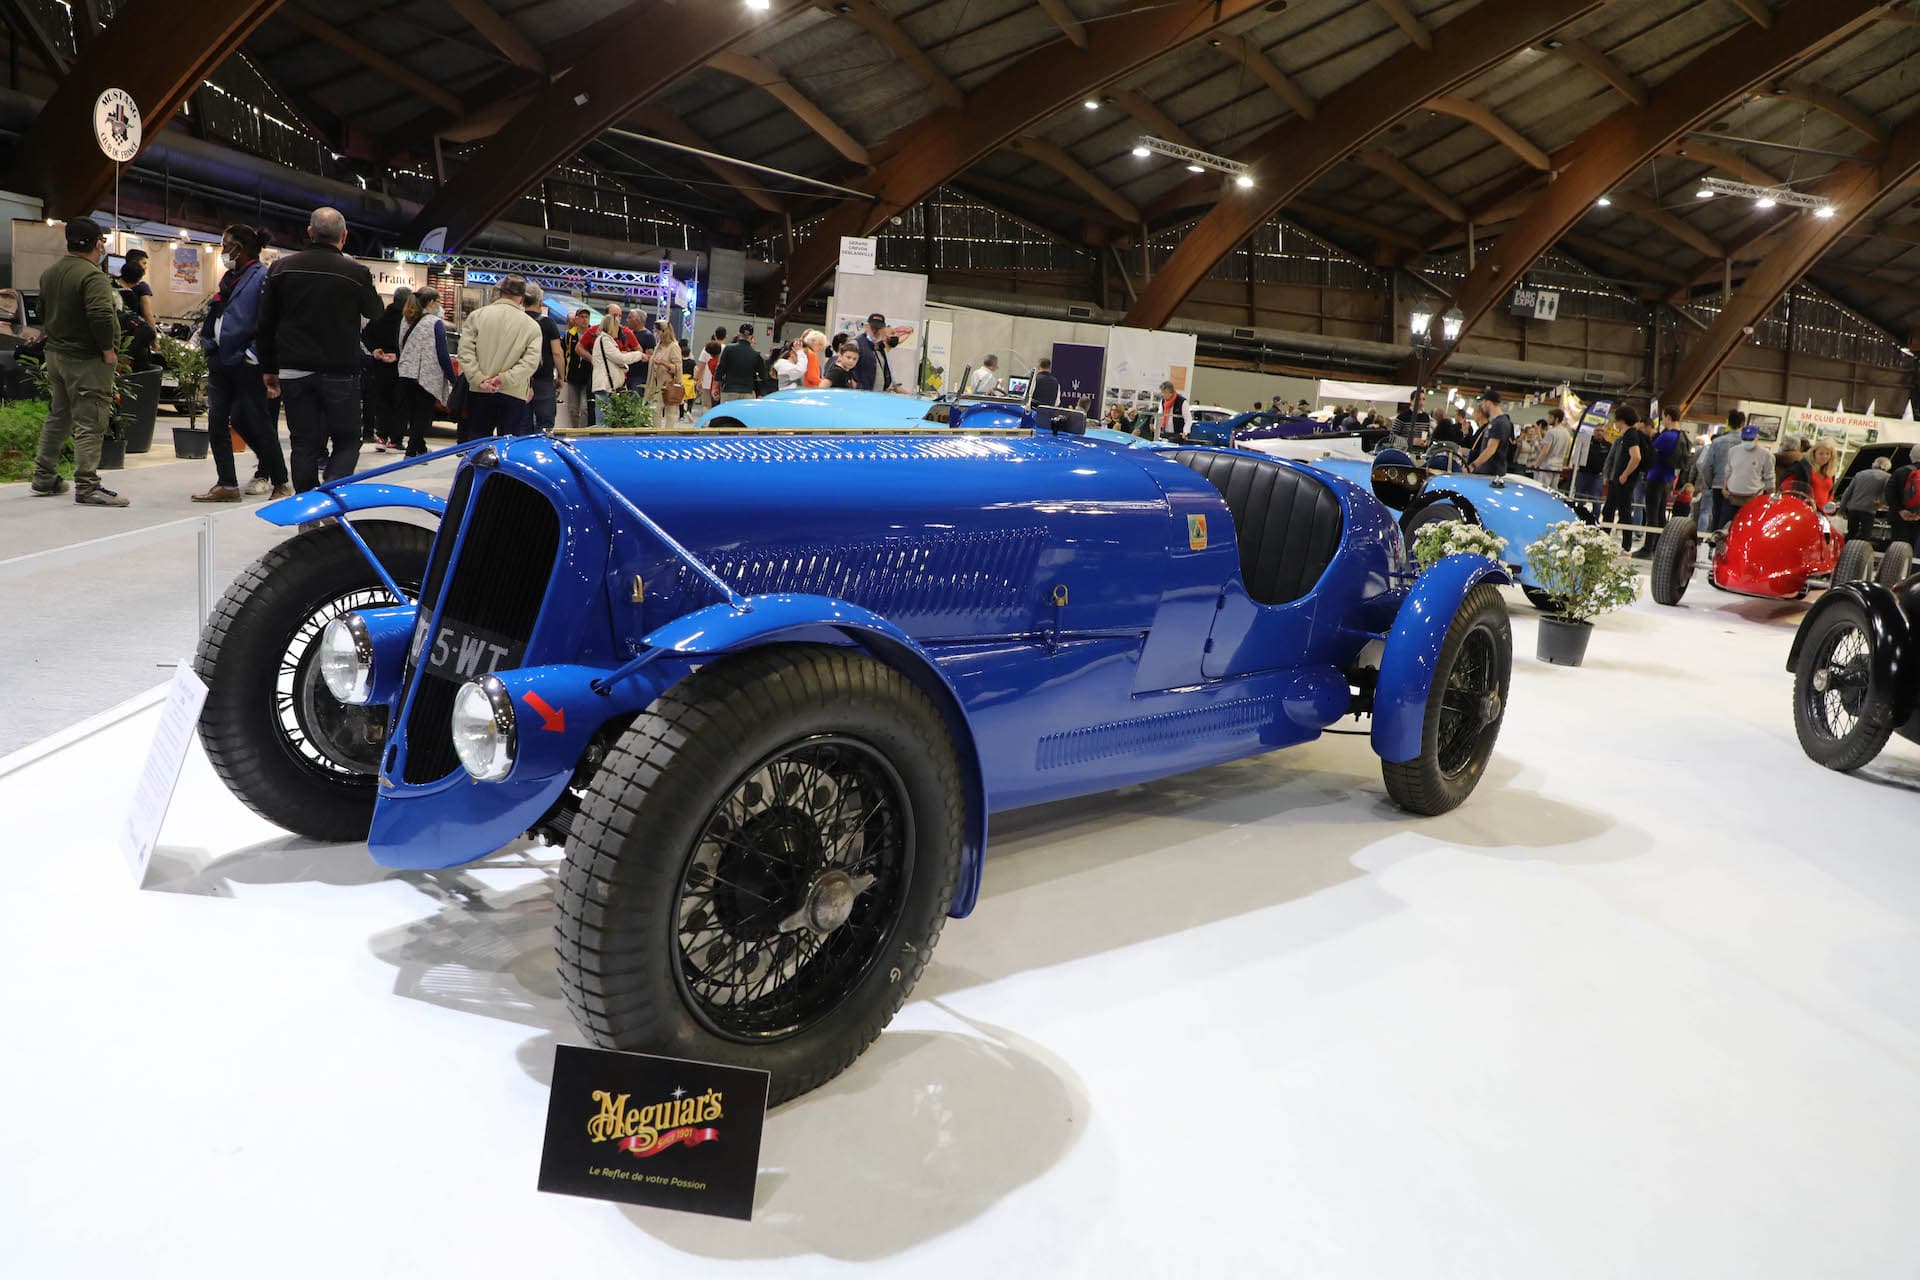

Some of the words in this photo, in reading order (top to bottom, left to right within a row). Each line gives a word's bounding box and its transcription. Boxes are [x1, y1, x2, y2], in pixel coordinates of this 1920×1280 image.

[102, 90, 137, 118] MUSTANG
[100, 132, 113, 153] CLUB
[120, 141, 138, 159] FRANCE
[379, 271, 415, 286] France
[1514, 298, 1536, 308] EXPO
[1515, 290, 1537, 300] PARC
[1061, 391, 1095, 400] ASERATI
[1800, 412, 1812, 420] SM
[1813, 414, 1834, 424] CLUB
[1836, 417, 1847, 425] DE
[1848, 419, 1879, 429] FRANCE
[587, 1088, 723, 1153] Meguiar's
[676, 1128, 693, 1139] 1901
[589, 1165, 600, 1175] Le
[602, 1167, 630, 1179] Reflet
[631, 1171, 644, 1182] de
[645, 1174, 669, 1185] votre
[670, 1176, 706, 1190] Passion
